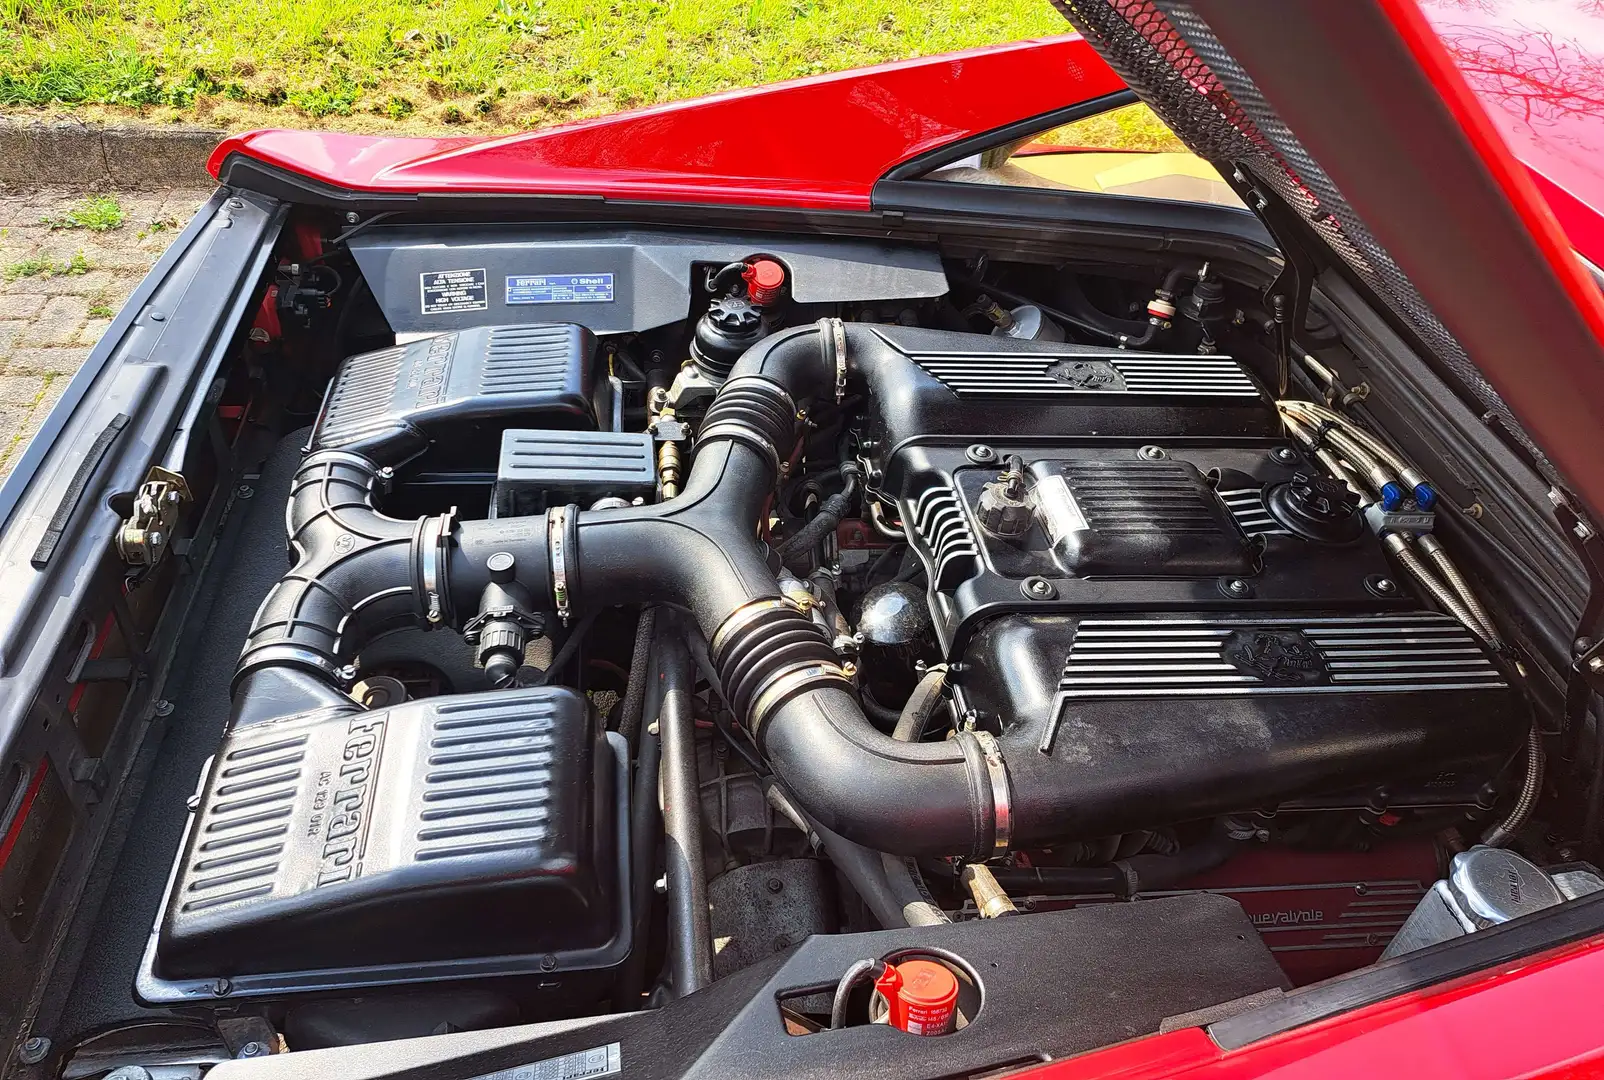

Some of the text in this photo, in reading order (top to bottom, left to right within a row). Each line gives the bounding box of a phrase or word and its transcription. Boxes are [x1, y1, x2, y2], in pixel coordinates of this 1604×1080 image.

[516, 278, 546, 287] Ferrari
[317, 711, 390, 888] Ferrari
[1248, 909, 1324, 924] uevalvole
